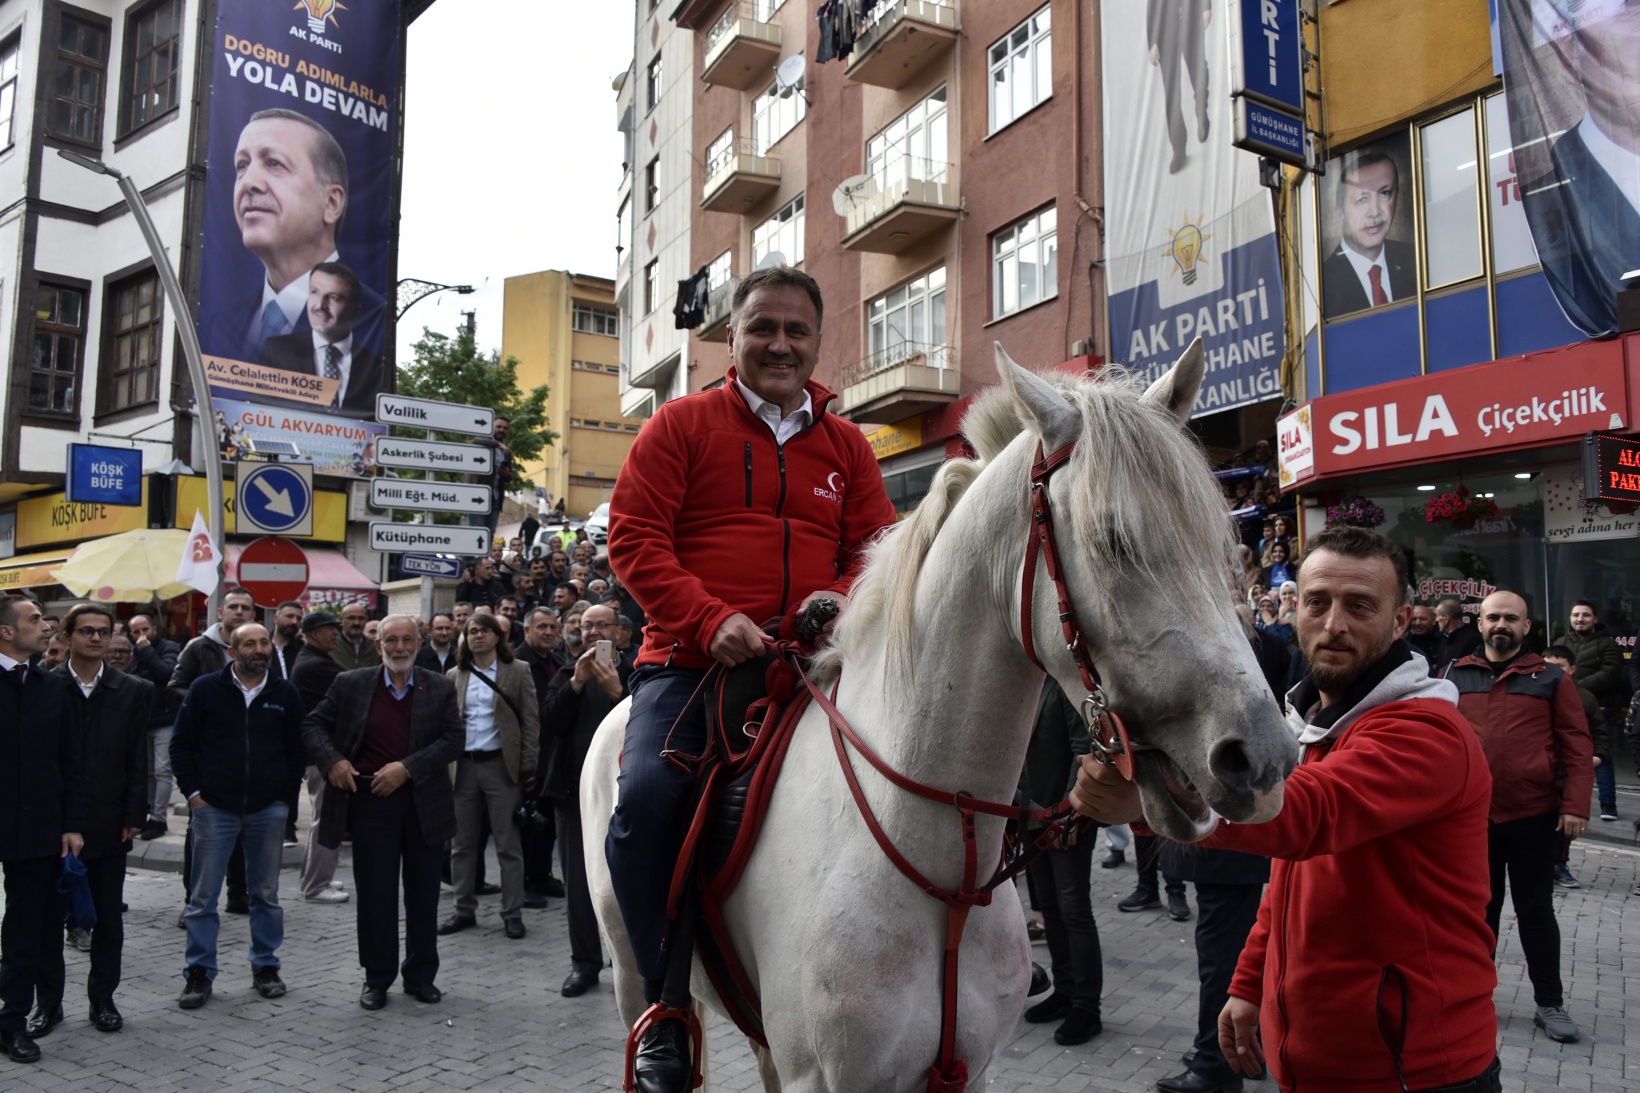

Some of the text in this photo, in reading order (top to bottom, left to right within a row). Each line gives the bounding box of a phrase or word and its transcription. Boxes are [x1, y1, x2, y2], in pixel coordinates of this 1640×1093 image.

[289, 26, 342, 54] AK PARTİ
[1261, 0, 1281, 86] RTİ
[225, 34, 388, 110] DOĞRU ADIMLARLA
[224, 53, 388, 132] YOLA DEVAM
[1251, 112, 1299, 137] GÜMÜŞHANE
[1251, 125, 1299, 148] İL BAŞKANLIĞI
[1128, 277, 1269, 362] AK PARTİ
[207, 361, 324, 391] Av. Celalettin KÖSE
[208, 374, 254, 388] Gümüşhane
[384, 403, 428, 420] Valilik
[1329, 386, 1607, 456] SILA Çiçekçilik
[242, 410, 367, 441] GÜL AKVARYUM
[1281, 426, 1302, 453] SILA
[381, 447, 464, 463] Askerlik Şubesi
[91, 461, 124, 477] KÖŞK
[91, 475, 124, 490] BÜFE
[377, 487, 460, 503] Milli Eğt. Müd.
[52, 500, 78, 531] KÖŞK
[376, 530, 451, 546] Kütüphane
[1548, 525, 1575, 538] sevgi
[1578, 522, 1612, 535] adına
[1614, 519, 1633, 532] her
[408, 559, 442, 571] TEK YÖN
[1419, 577, 1496, 600] ÇİÇEKÇİLİK
